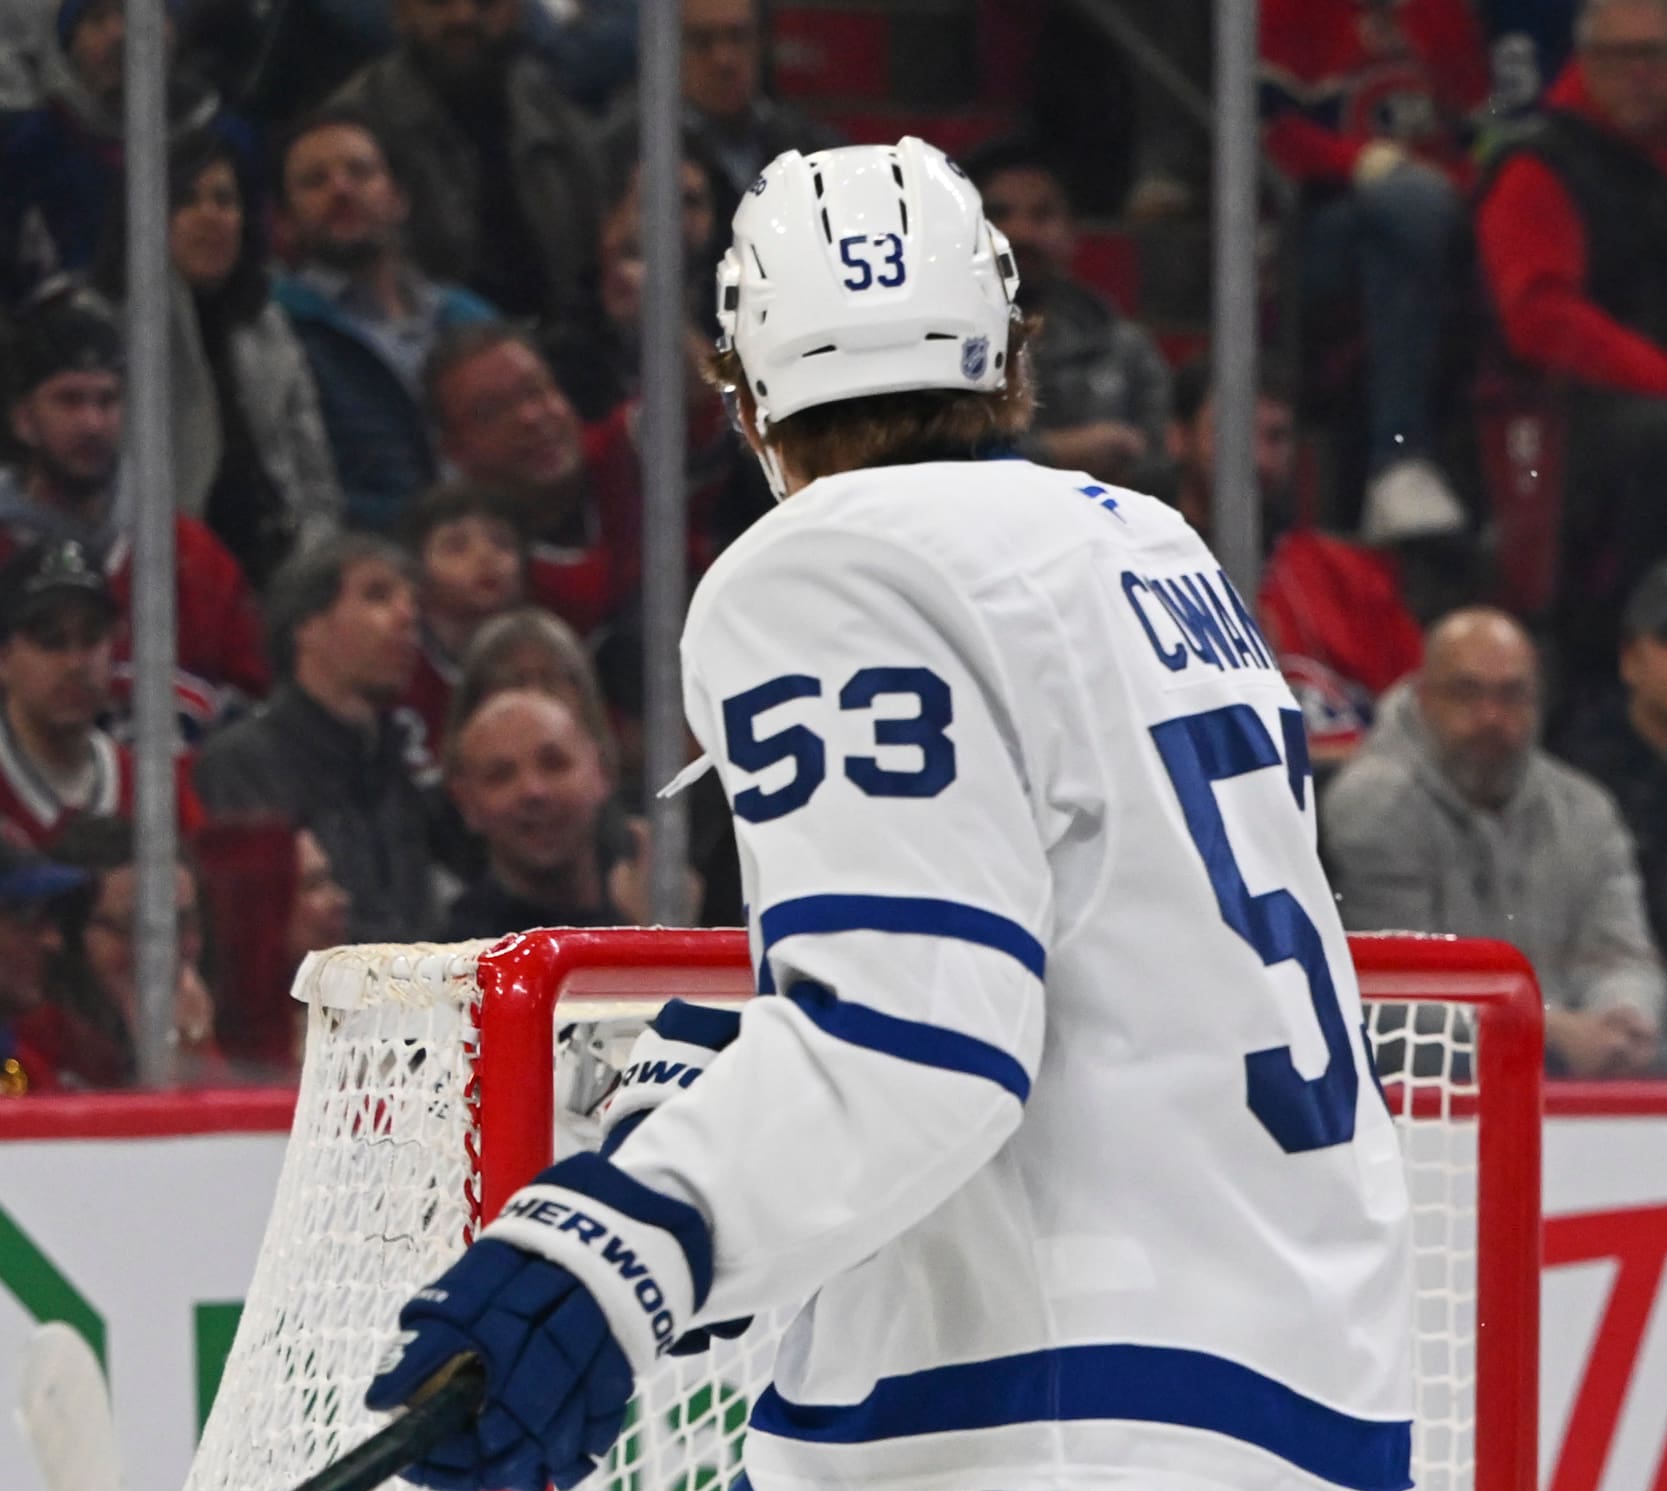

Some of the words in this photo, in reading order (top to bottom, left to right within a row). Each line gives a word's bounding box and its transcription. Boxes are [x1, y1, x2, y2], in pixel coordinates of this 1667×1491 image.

[839, 232, 907, 292] 53
[720, 665, 958, 824] 53
[1147, 703, 1394, 1154] 5
[502, 1198, 678, 1360] HERWOO
